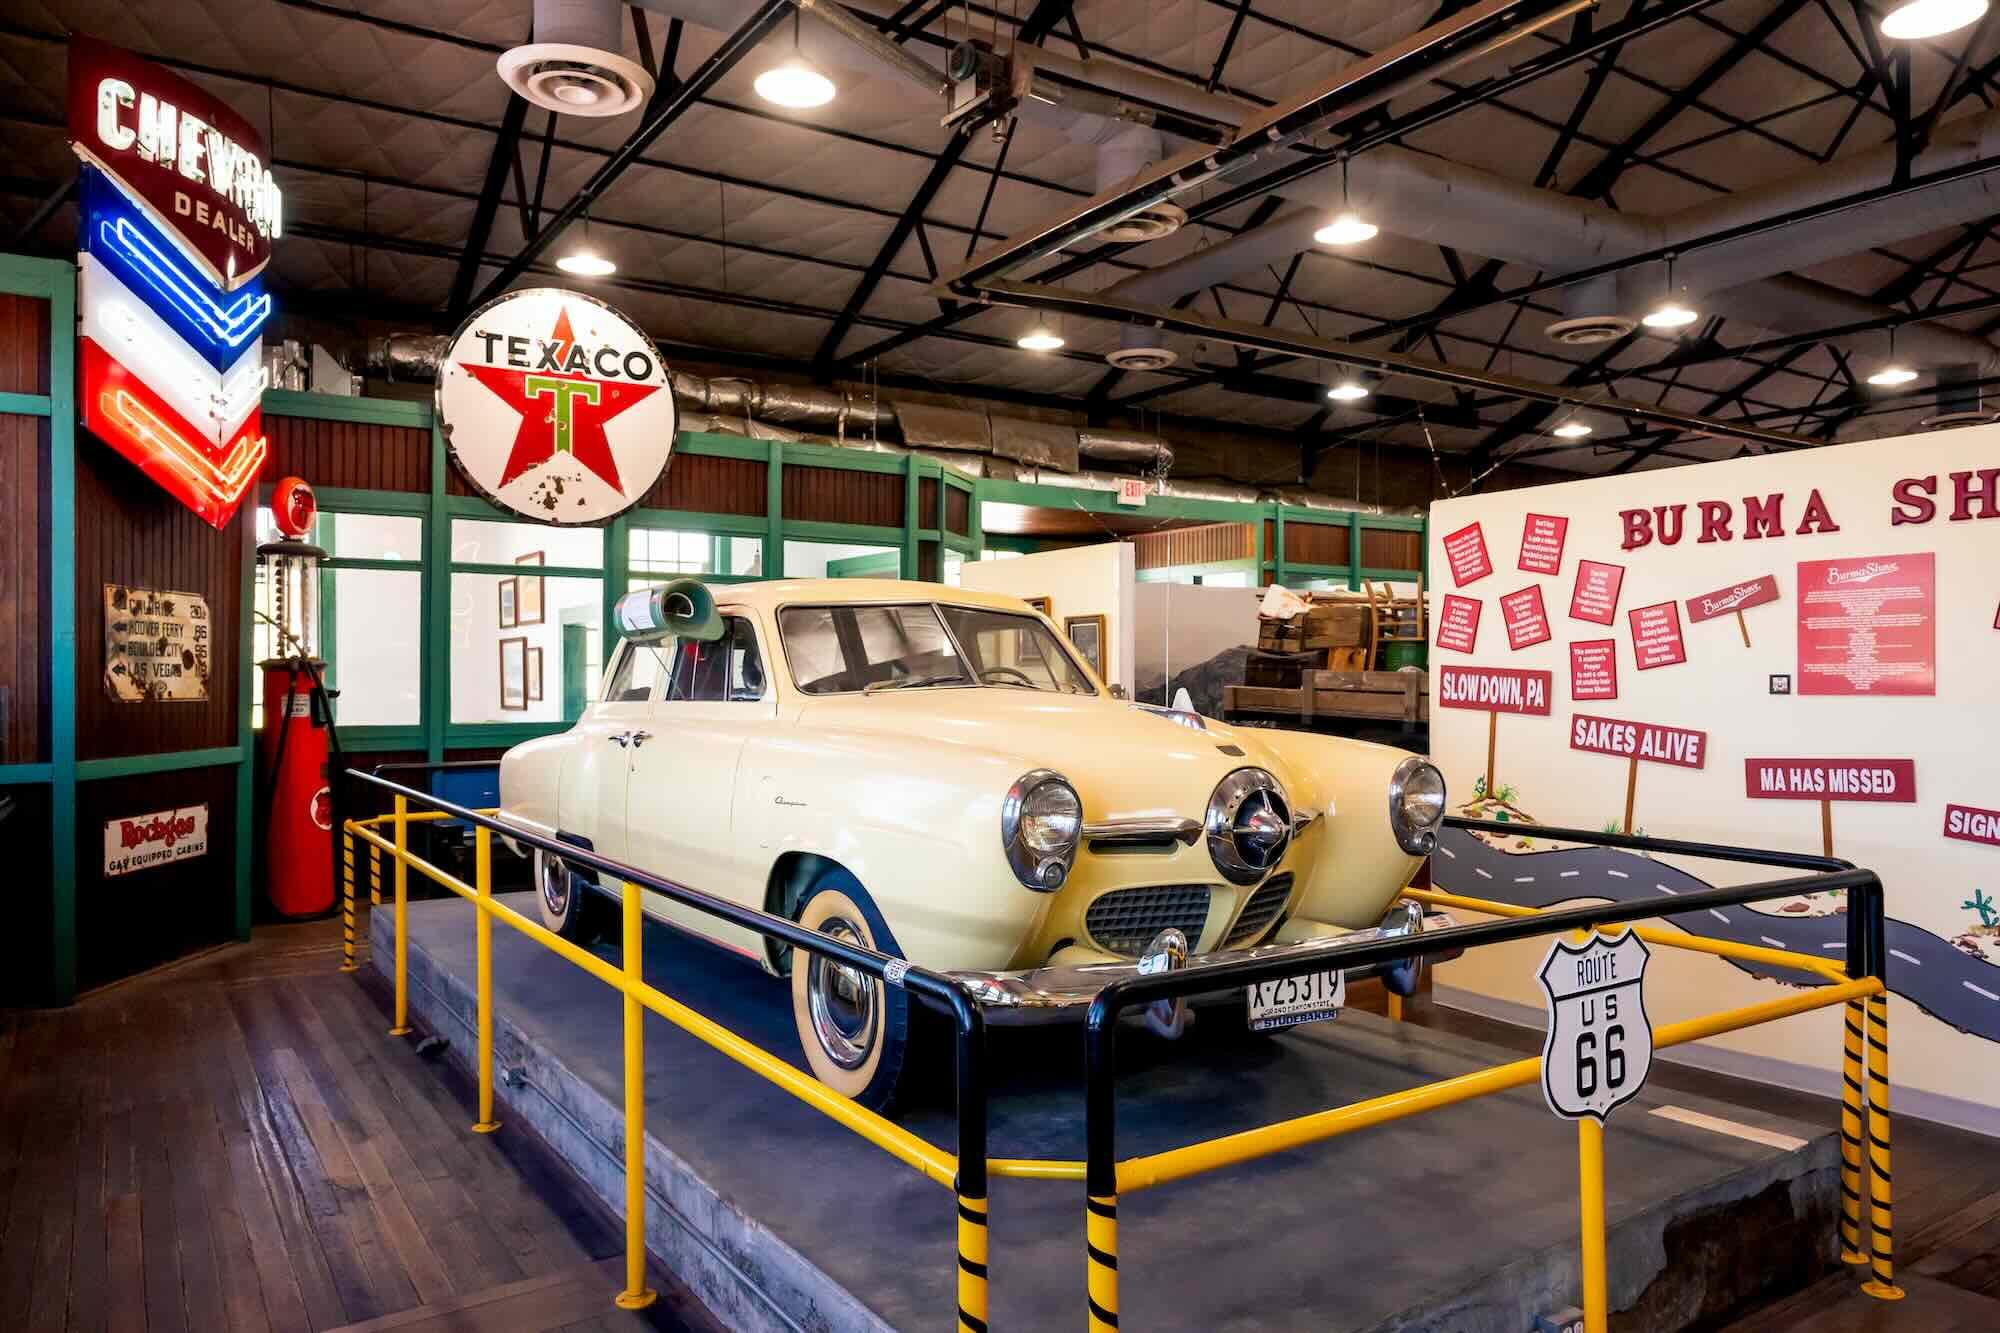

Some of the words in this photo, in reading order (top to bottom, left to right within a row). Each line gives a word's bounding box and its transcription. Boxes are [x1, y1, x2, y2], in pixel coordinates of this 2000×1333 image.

[175, 191, 254, 253] DEALER
[475, 330, 653, 381] TEXACO
[525, 376, 600, 455] T
[1618, 488, 1840, 551] BURMA
[1891, 468, 2000, 527] SH
[128, 641, 168, 657] BOULDE
[153, 663, 183, 678] VEGA
[1443, 673, 1480, 701] SLOW
[1479, 677, 1523, 711] DOWN,
[1526, 679, 1544, 707] PA
[1575, 719, 1636, 754] SAKES
[1640, 731, 1699, 763] ALIVE
[1760, 768, 1786, 791] MA
[1790, 768, 1824, 792] HAS
[1829, 768, 1896, 794] MISSED
[1949, 810, 2000, 839] SIGN
[132, 849, 172, 865] EQUIPPED
[176, 842, 204, 856] CABINS
[1577, 952, 1616, 987] ROUTE
[1263, 1010, 1336, 1028] STUDEBAKER
[1575, 1024, 1625, 1097] 66
